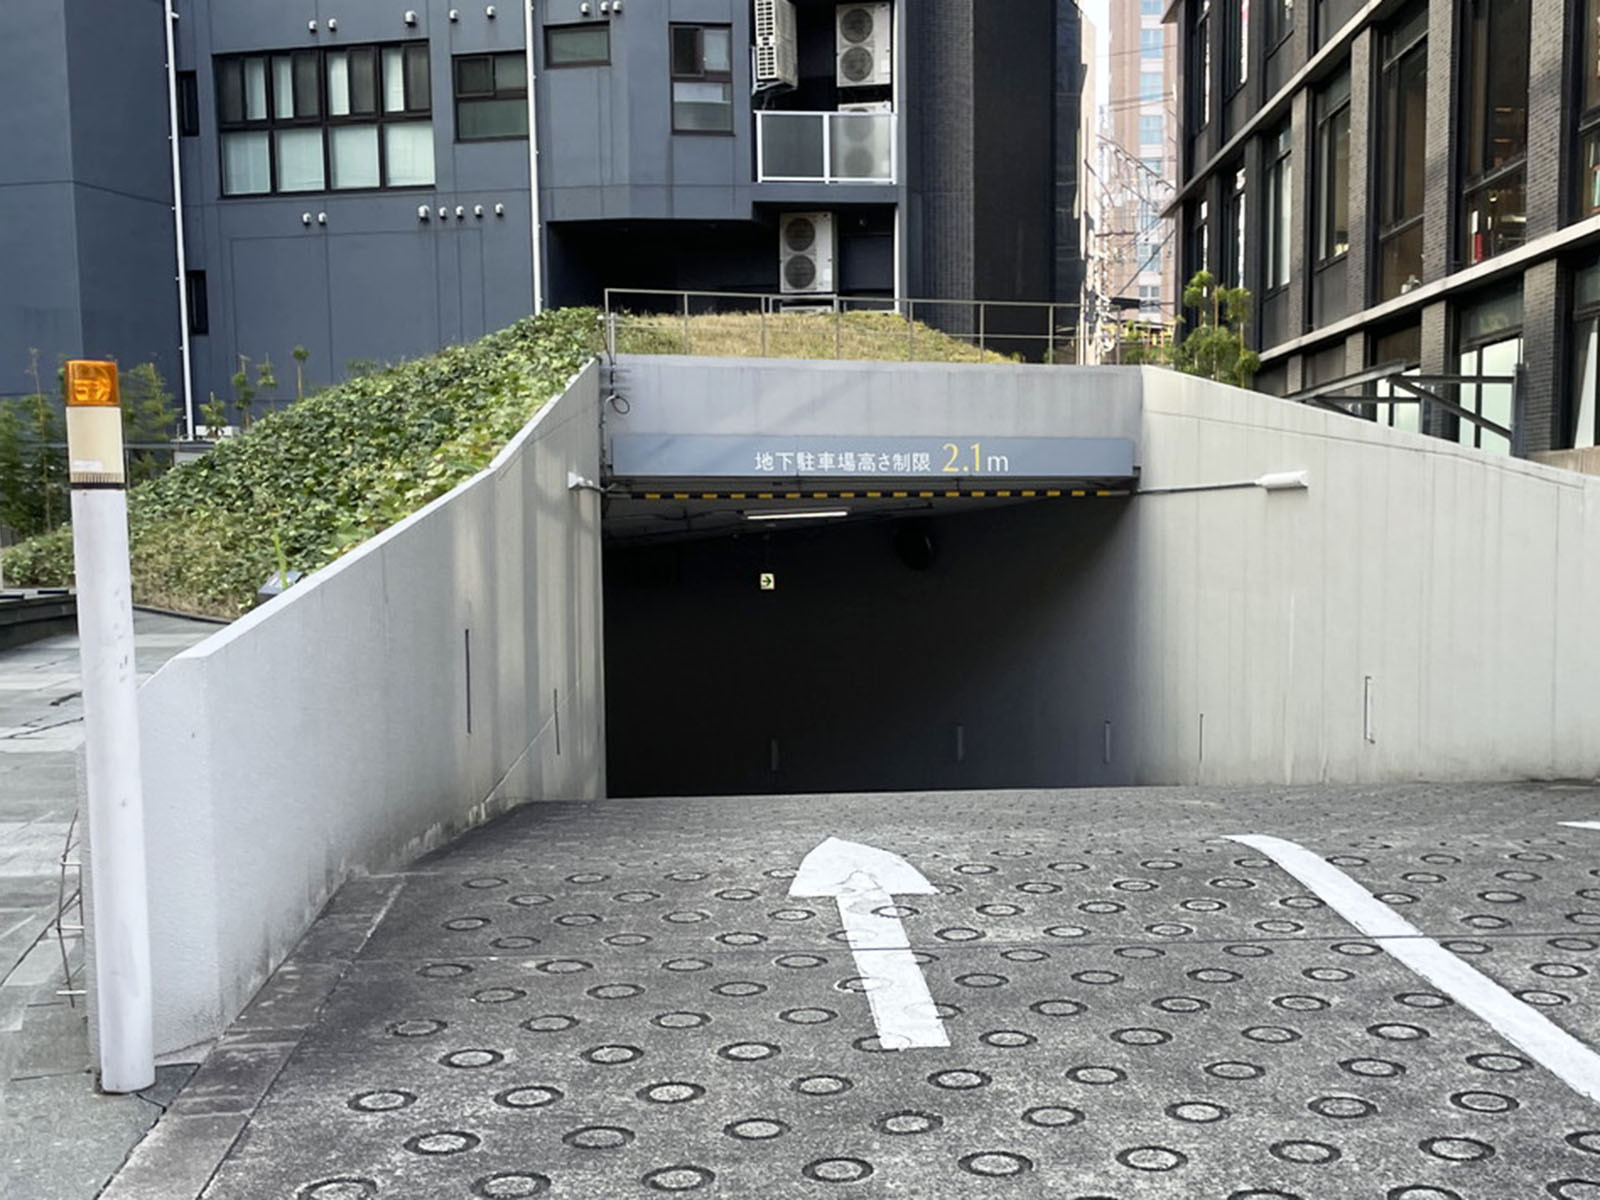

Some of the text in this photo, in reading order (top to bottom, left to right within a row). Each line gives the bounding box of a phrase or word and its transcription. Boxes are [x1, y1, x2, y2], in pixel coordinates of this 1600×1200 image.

[754, 451, 931, 472] 地下駐車場高さ制限
